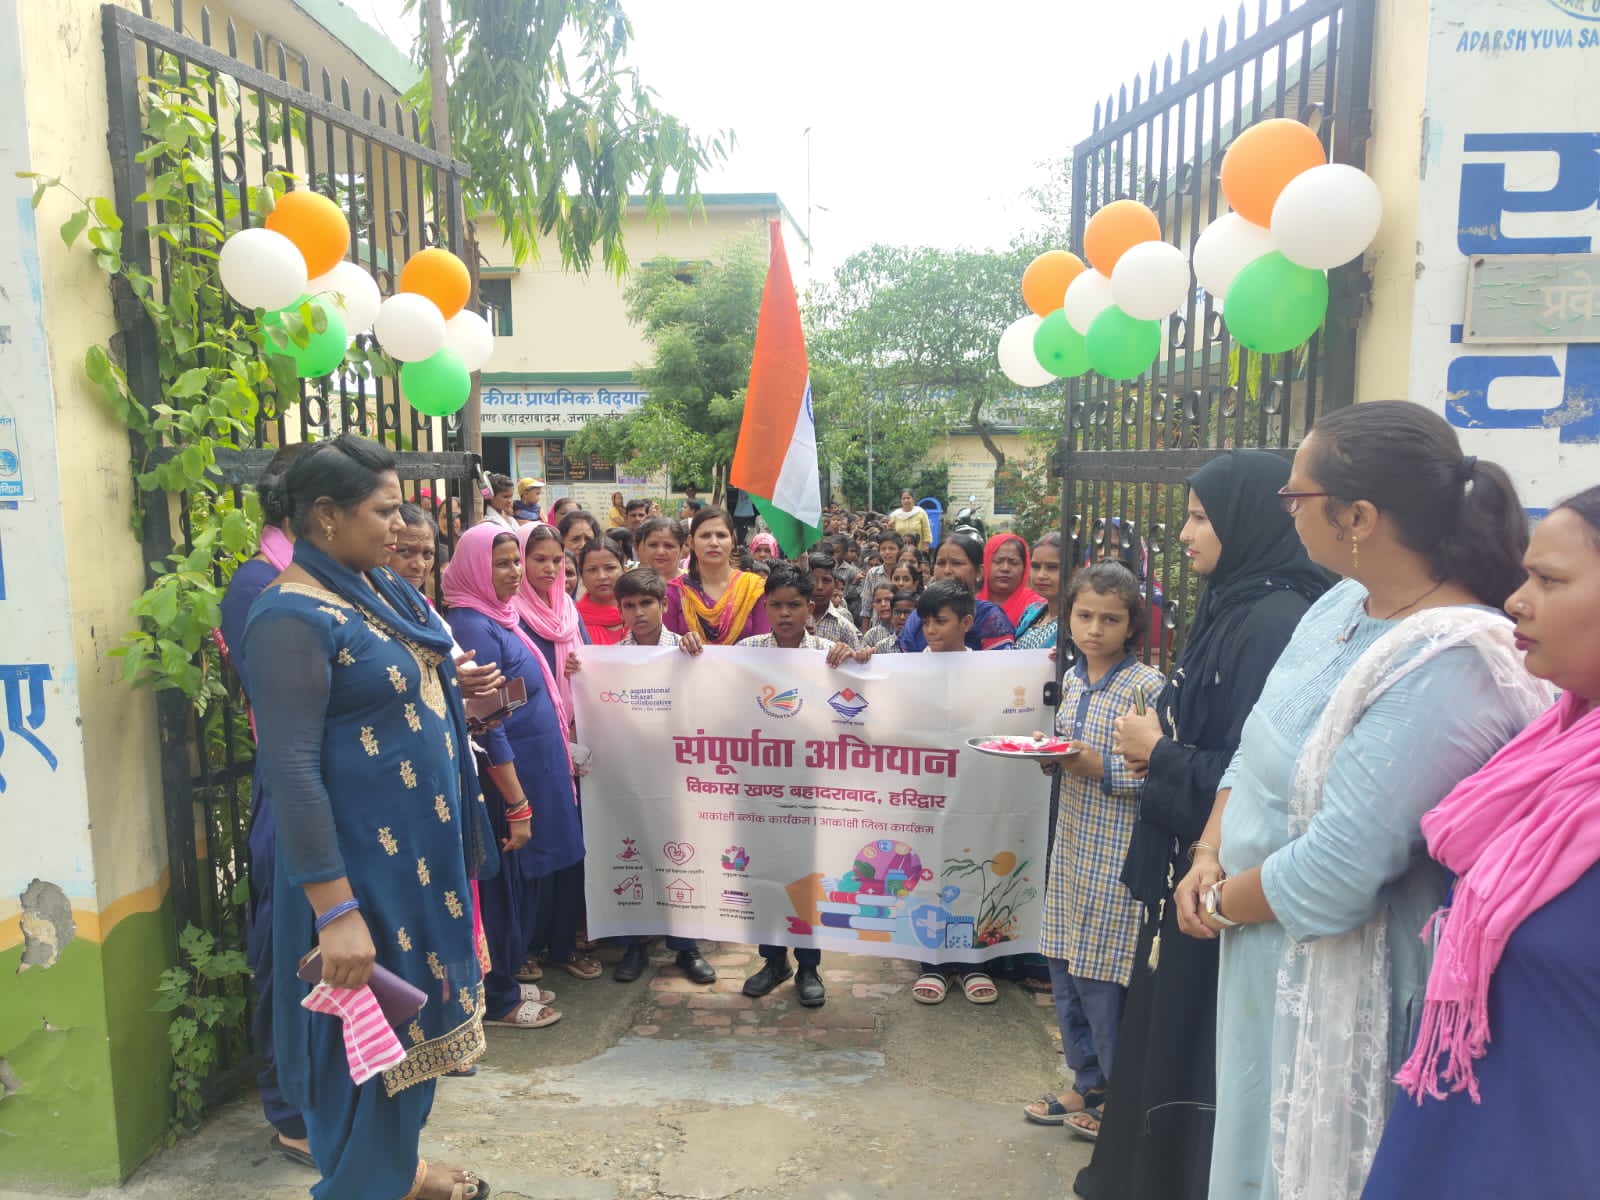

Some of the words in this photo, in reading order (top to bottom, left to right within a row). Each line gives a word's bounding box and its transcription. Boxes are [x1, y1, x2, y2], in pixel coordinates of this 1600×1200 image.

[1455, 29, 1527, 52] ADARSH
[1530, 29, 1573, 49] YUVA
[1540, 271, 1600, 320] प्रवे
[480, 388, 522, 406] कीयः
[671, 728, 797, 775] संपूर्णता
[805, 733, 961, 778] अभियान
[686, 776, 739, 795] विकास
[743, 783, 785, 798] खण्ड
[888, 788, 948, 809] हरिद्वार
[861, 818, 889, 832] जिला
